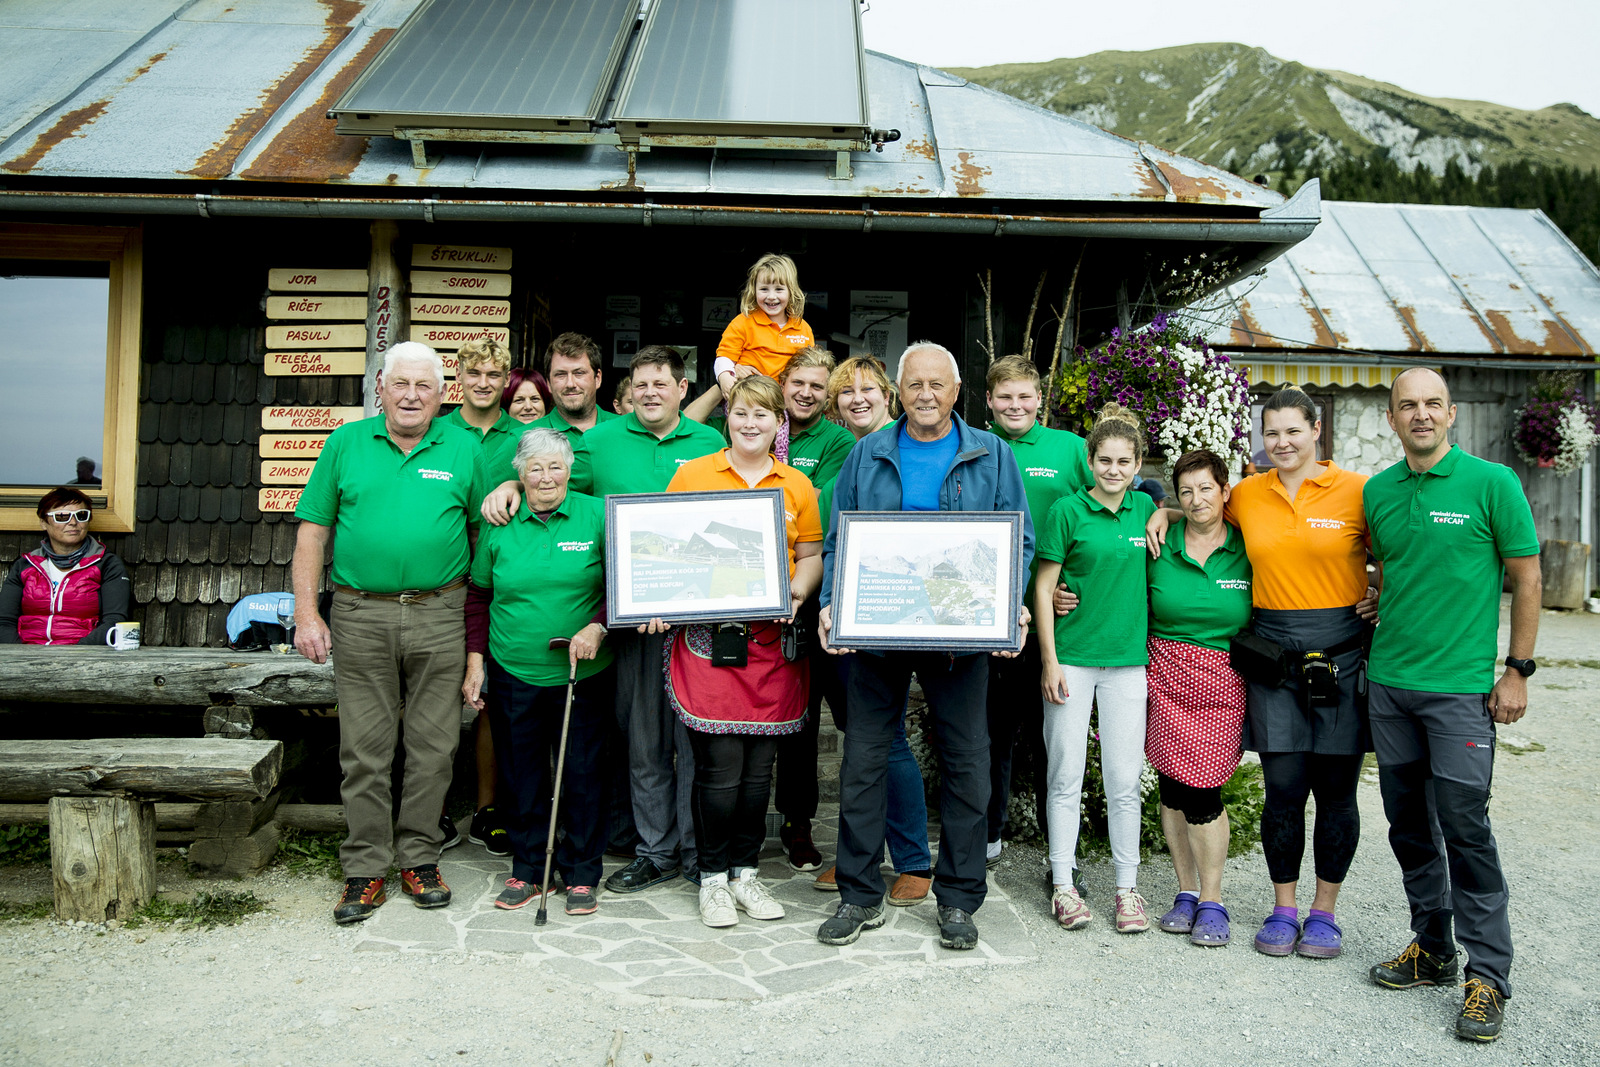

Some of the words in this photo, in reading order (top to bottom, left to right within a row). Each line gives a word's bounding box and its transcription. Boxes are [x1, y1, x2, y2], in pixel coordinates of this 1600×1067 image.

[431, 246, 497, 263] ŠTRUKLJI:
[288, 275, 317, 285] JOTA
[442, 277, 487, 288] -SIROVI
[288, 299, 322, 312] RIČET
[414, 304, 460, 314] -AJDOVI
[461, 305, 471, 315] Z
[472, 305, 508, 316] OREHI
[376, 286, 391, 353] DANES
[286, 330, 331, 341] PASULJ
[274, 352, 322, 364] TELEČJA
[291, 364, 331, 373] OBARA
[269, 408, 331, 417] KRANJSKA
[291, 418, 344, 428] KLOBASA
[273, 440, 307, 450] KISLO
[309, 440, 326, 449] ZE
[269, 467, 310, 477] ZIMSKI
[1433, 517, 1464, 525] KOFCAH
